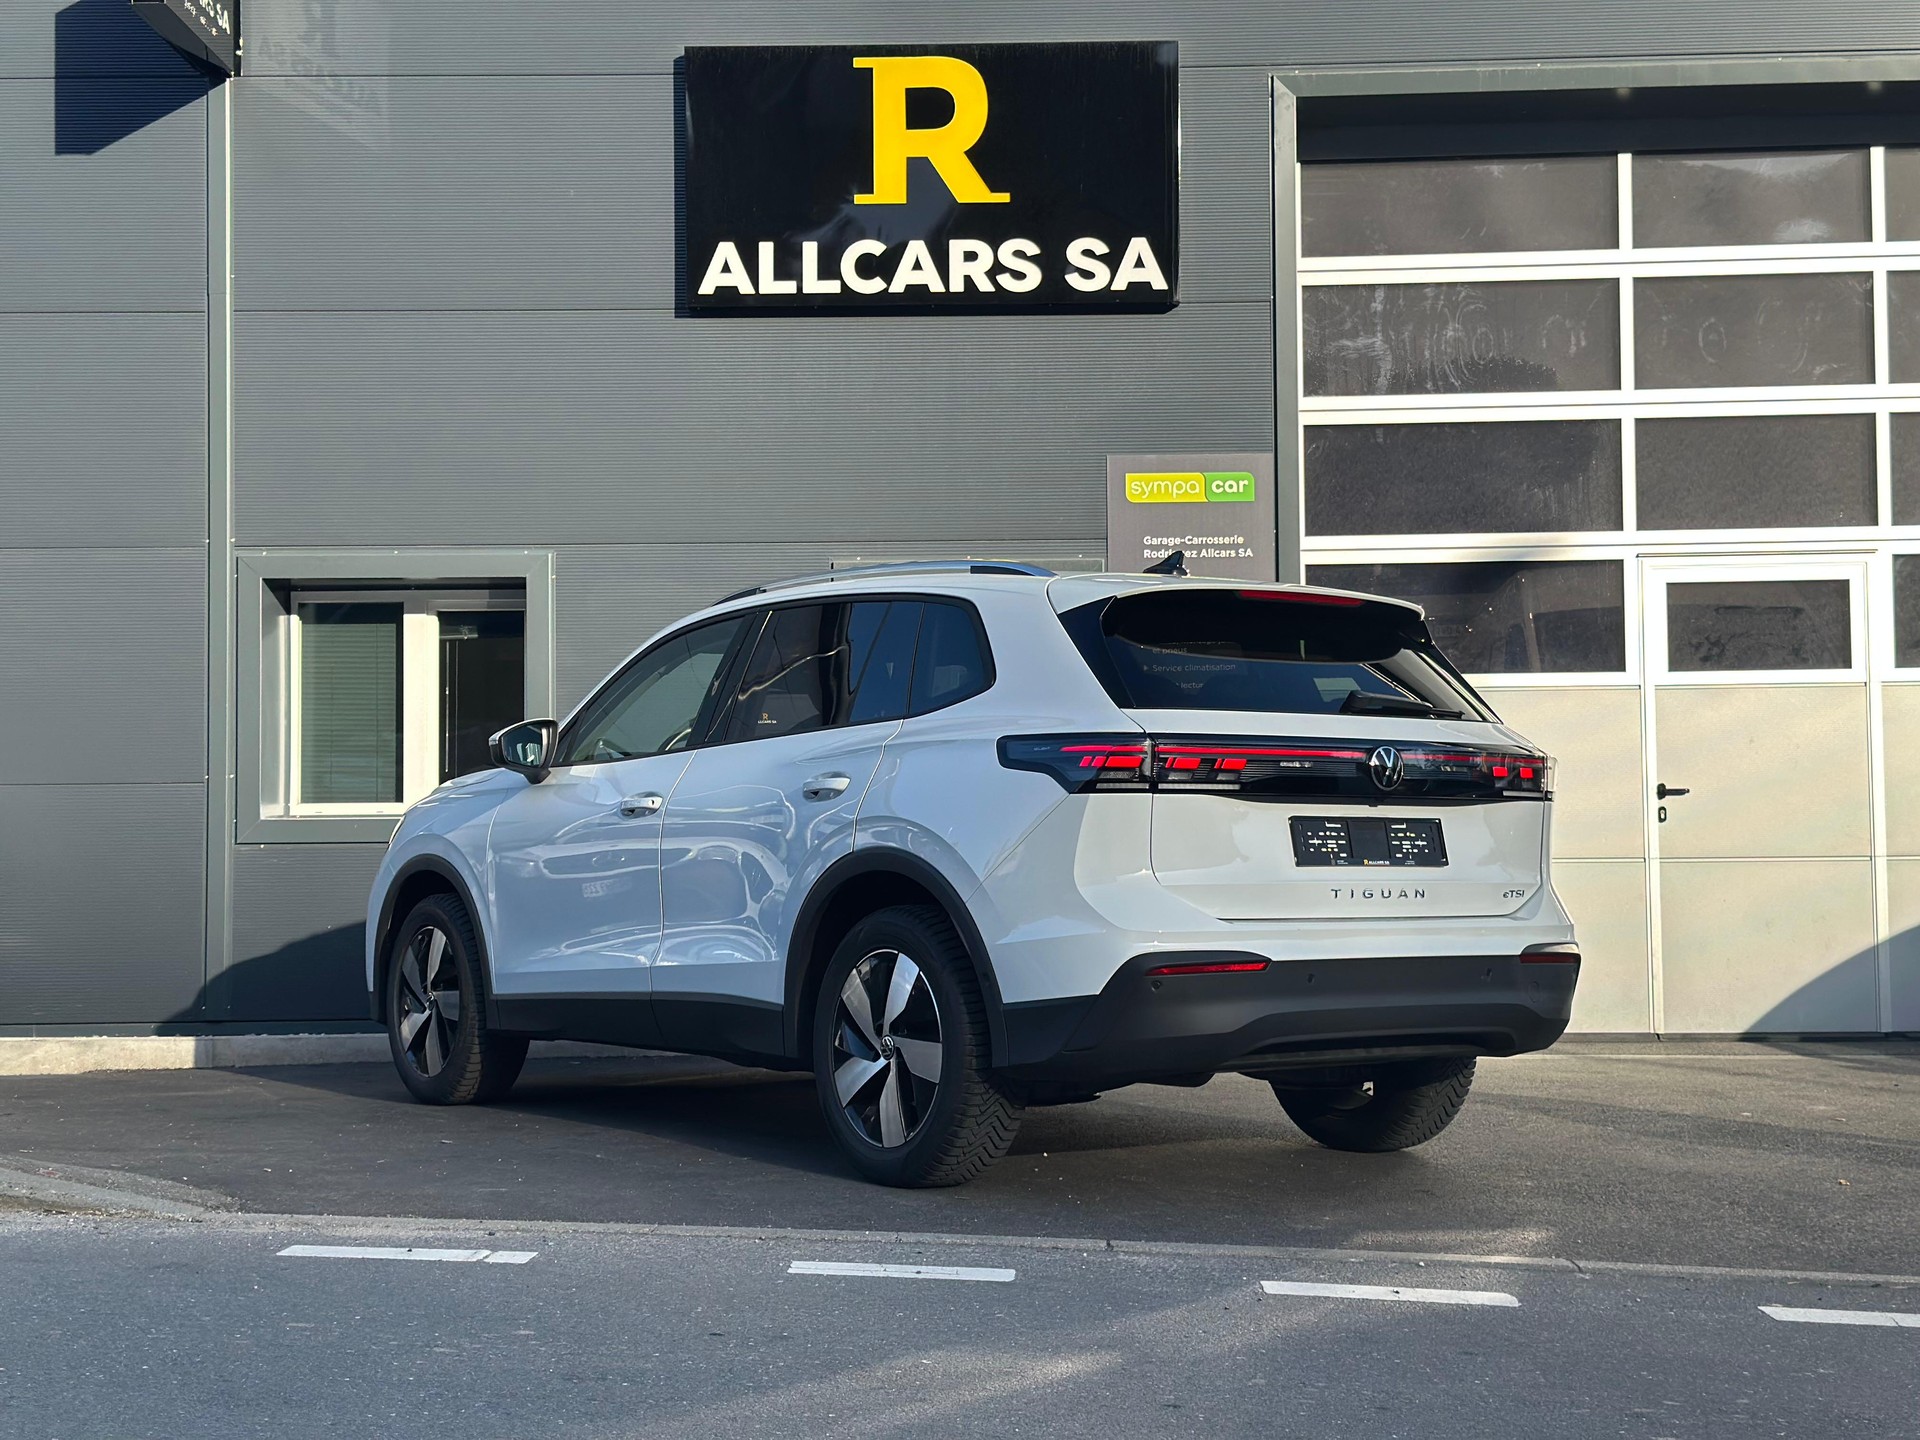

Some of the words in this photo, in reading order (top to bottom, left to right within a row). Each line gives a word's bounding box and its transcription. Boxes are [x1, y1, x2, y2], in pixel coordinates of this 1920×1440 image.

[853, 56, 1011, 204] R
[697, 238, 1043, 295] ALLCARS
[1065, 237, 1169, 292] SA
[1130, 480, 1200, 499] sympa
[1211, 479, 1249, 493] car
[1143, 534, 1245, 546] Garage-Carrosserie
[1200, 548, 1236, 558] Allcars
[1238, 548, 1254, 558] SA
[1152, 664, 1182, 672] Service
[1184, 663, 1236, 671] climatisation
[1331, 889, 1427, 899] TIGUAN
[1503, 890, 1525, 898] eTSI
